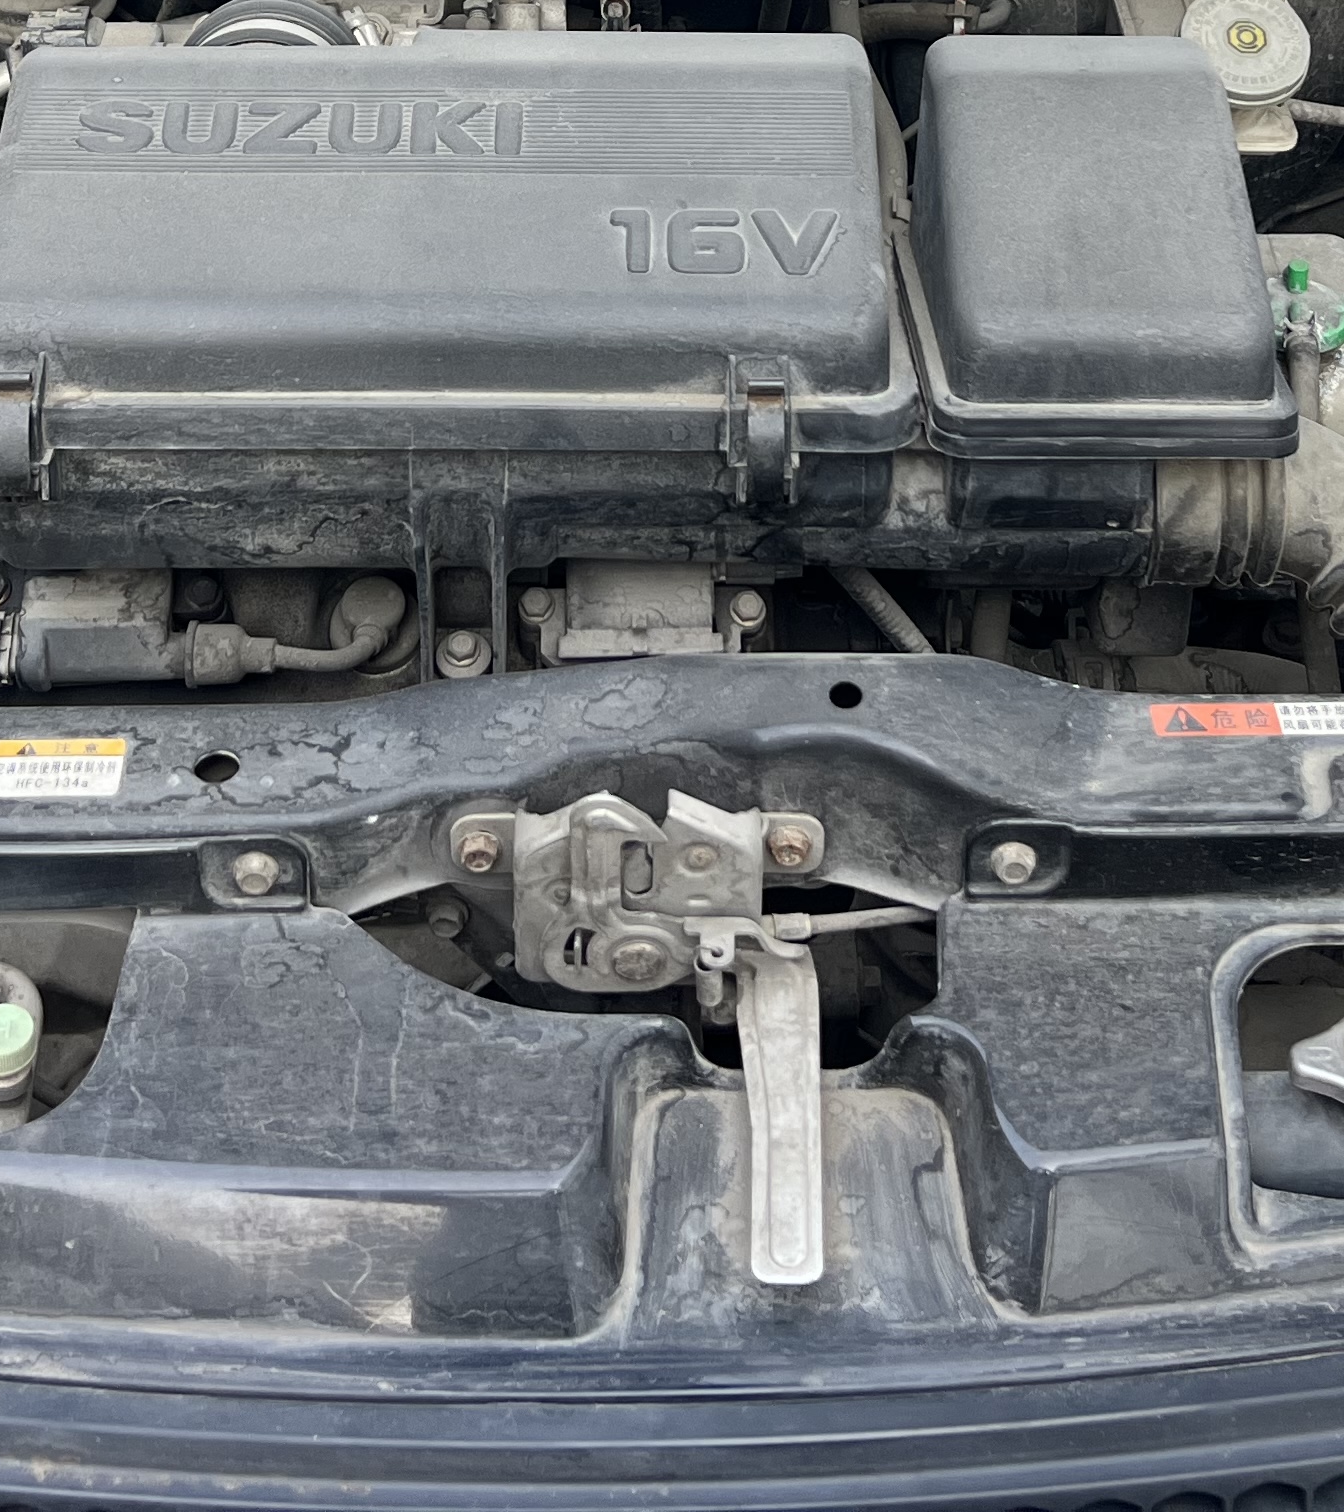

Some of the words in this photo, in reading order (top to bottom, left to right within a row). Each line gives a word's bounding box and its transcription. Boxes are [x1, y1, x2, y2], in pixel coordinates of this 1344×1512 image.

[76, 99, 525, 156] SUZUKI
[607, 205, 847, 277] 16V
[1211, 707, 1271, 730] 危险
[15, 777, 90, 789] HFC-134a
